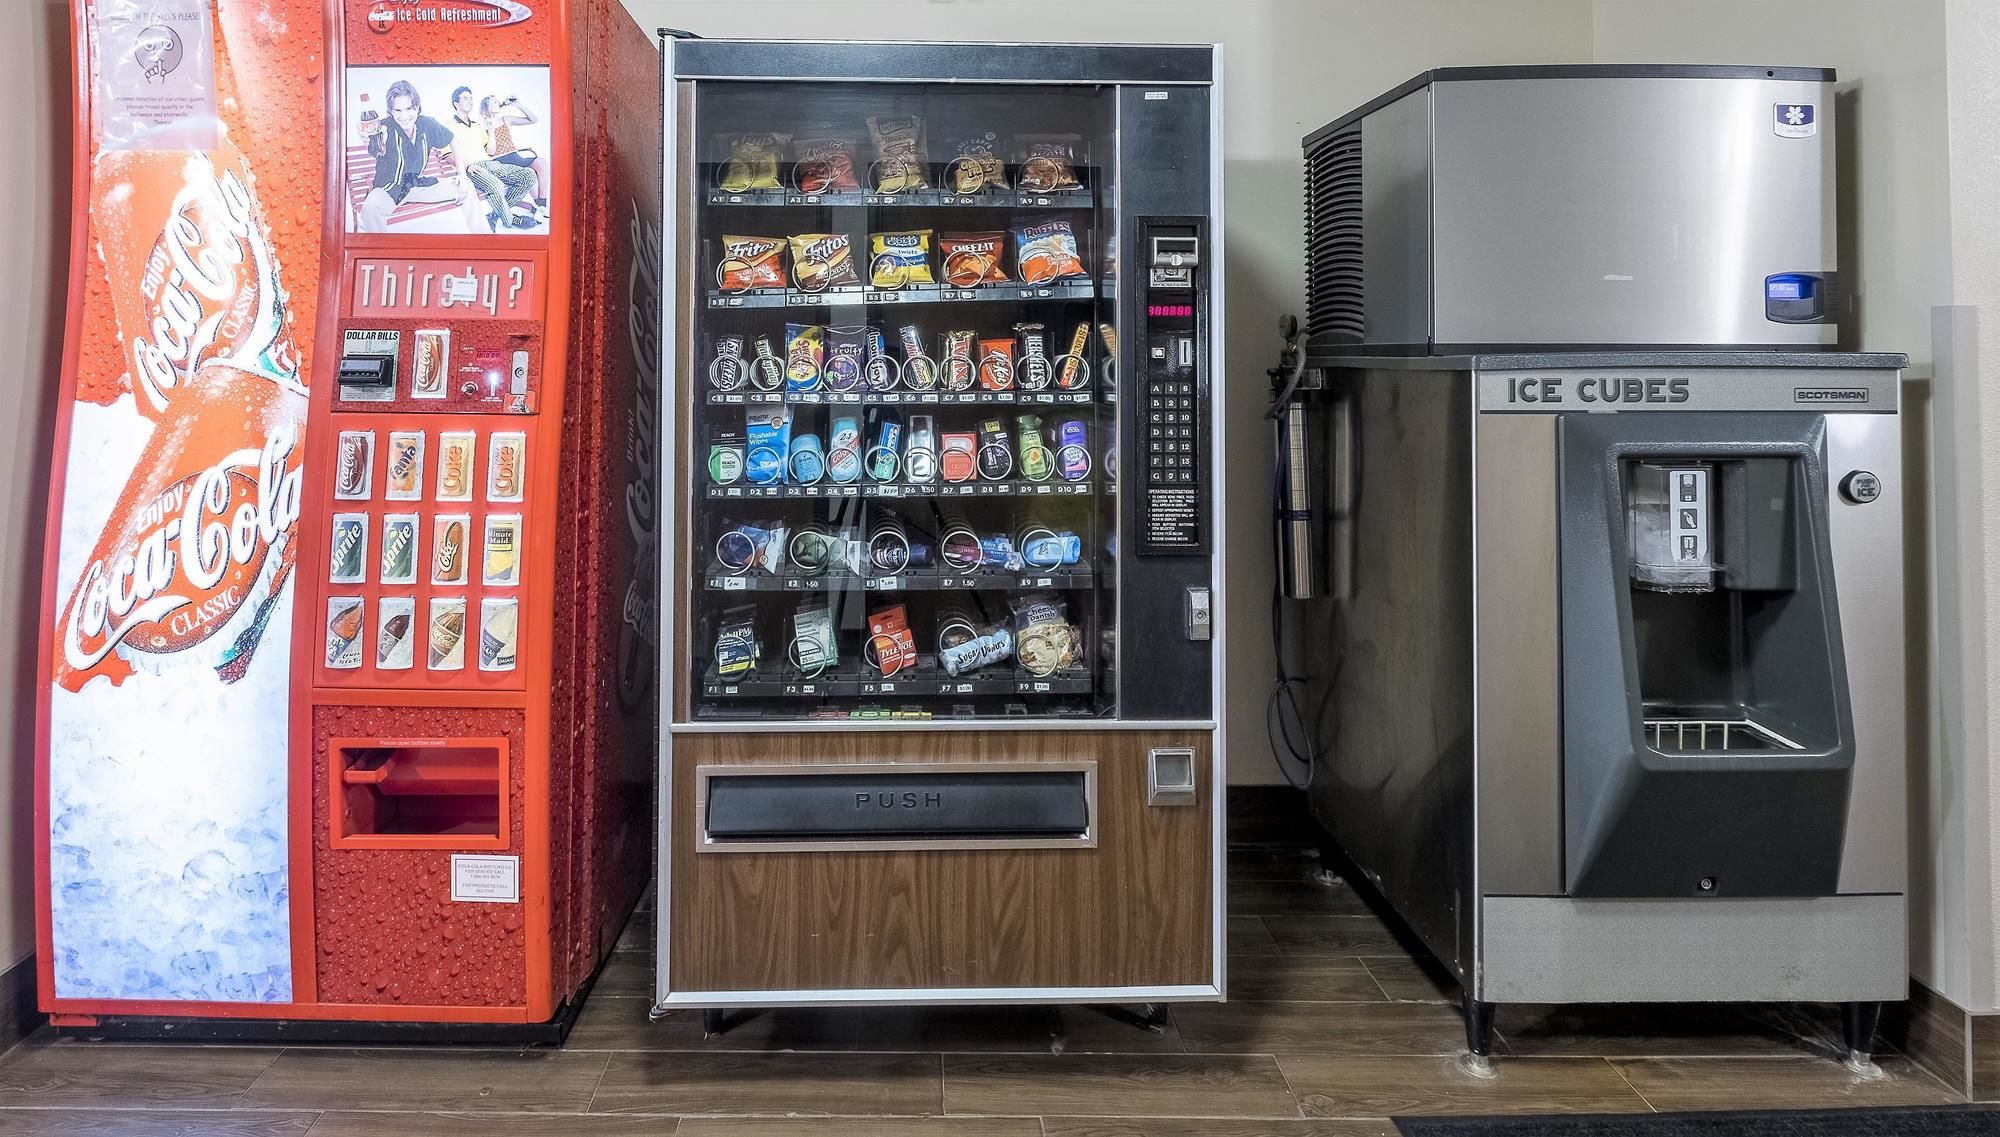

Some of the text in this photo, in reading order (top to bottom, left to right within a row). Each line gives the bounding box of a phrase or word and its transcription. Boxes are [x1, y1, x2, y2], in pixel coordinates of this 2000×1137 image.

[178, 12, 200, 20] PLEASE
[397, 7, 411, 21] Ice
[416, 7, 436, 21] Cold
[441, 7, 502, 23] Refreshment
[1023, 220, 1071, 240] RUFFLES
[803, 234, 849, 266] Fritos
[952, 242, 995, 252] CHEEZ-IT
[140, 245, 170, 301] Enjoy
[222, 278, 258, 338] CLASSIC
[346, 331, 399, 341] DOLLAR BILLS
[720, 338, 740, 391] SNCKERS
[952, 337, 970, 382] TWIX
[871, 363, 882, 384] joy
[1507, 377, 1690, 403] ICE CUBES
[1797, 389, 1866, 400] SCOTSMAN
[1152, 399, 1160, 407] B
[1168, 399, 1174, 407] 2
[1182, 399, 1189, 407] 9
[748, 414, 769, 422] equate
[749, 432, 778, 440] Flushable
[1152, 428, 1160, 436] D
[1168, 428, 1174, 436] 4
[1182, 428, 1190, 436] 11
[749, 438, 769, 447] Wipes
[832, 440, 860, 463] Colgte
[340, 441, 356, 492] Coca-Cola
[390, 445, 417, 480] Fanta
[443, 445, 464, 489] Coke
[1152, 457, 1160, 465] F
[1168, 457, 1174, 465] 6
[495, 446, 516, 492] Coke
[1152, 472, 1160, 480] G
[1168, 472, 1174, 480] 7
[1182, 472, 1190, 480] 14
[1857, 487, 1876, 497] ICE
[137, 482, 184, 532] Enjoy
[64, 418, 303, 671] Coca-Cola
[170, 585, 242, 637] CLASSIC
[1030, 610, 1055, 622] Danish
[738, 626, 752, 637] PM
[880, 641, 913, 660] TYLENOL
[980, 640, 1006, 658] DONUTS
[855, 792, 941, 809] PUSH
